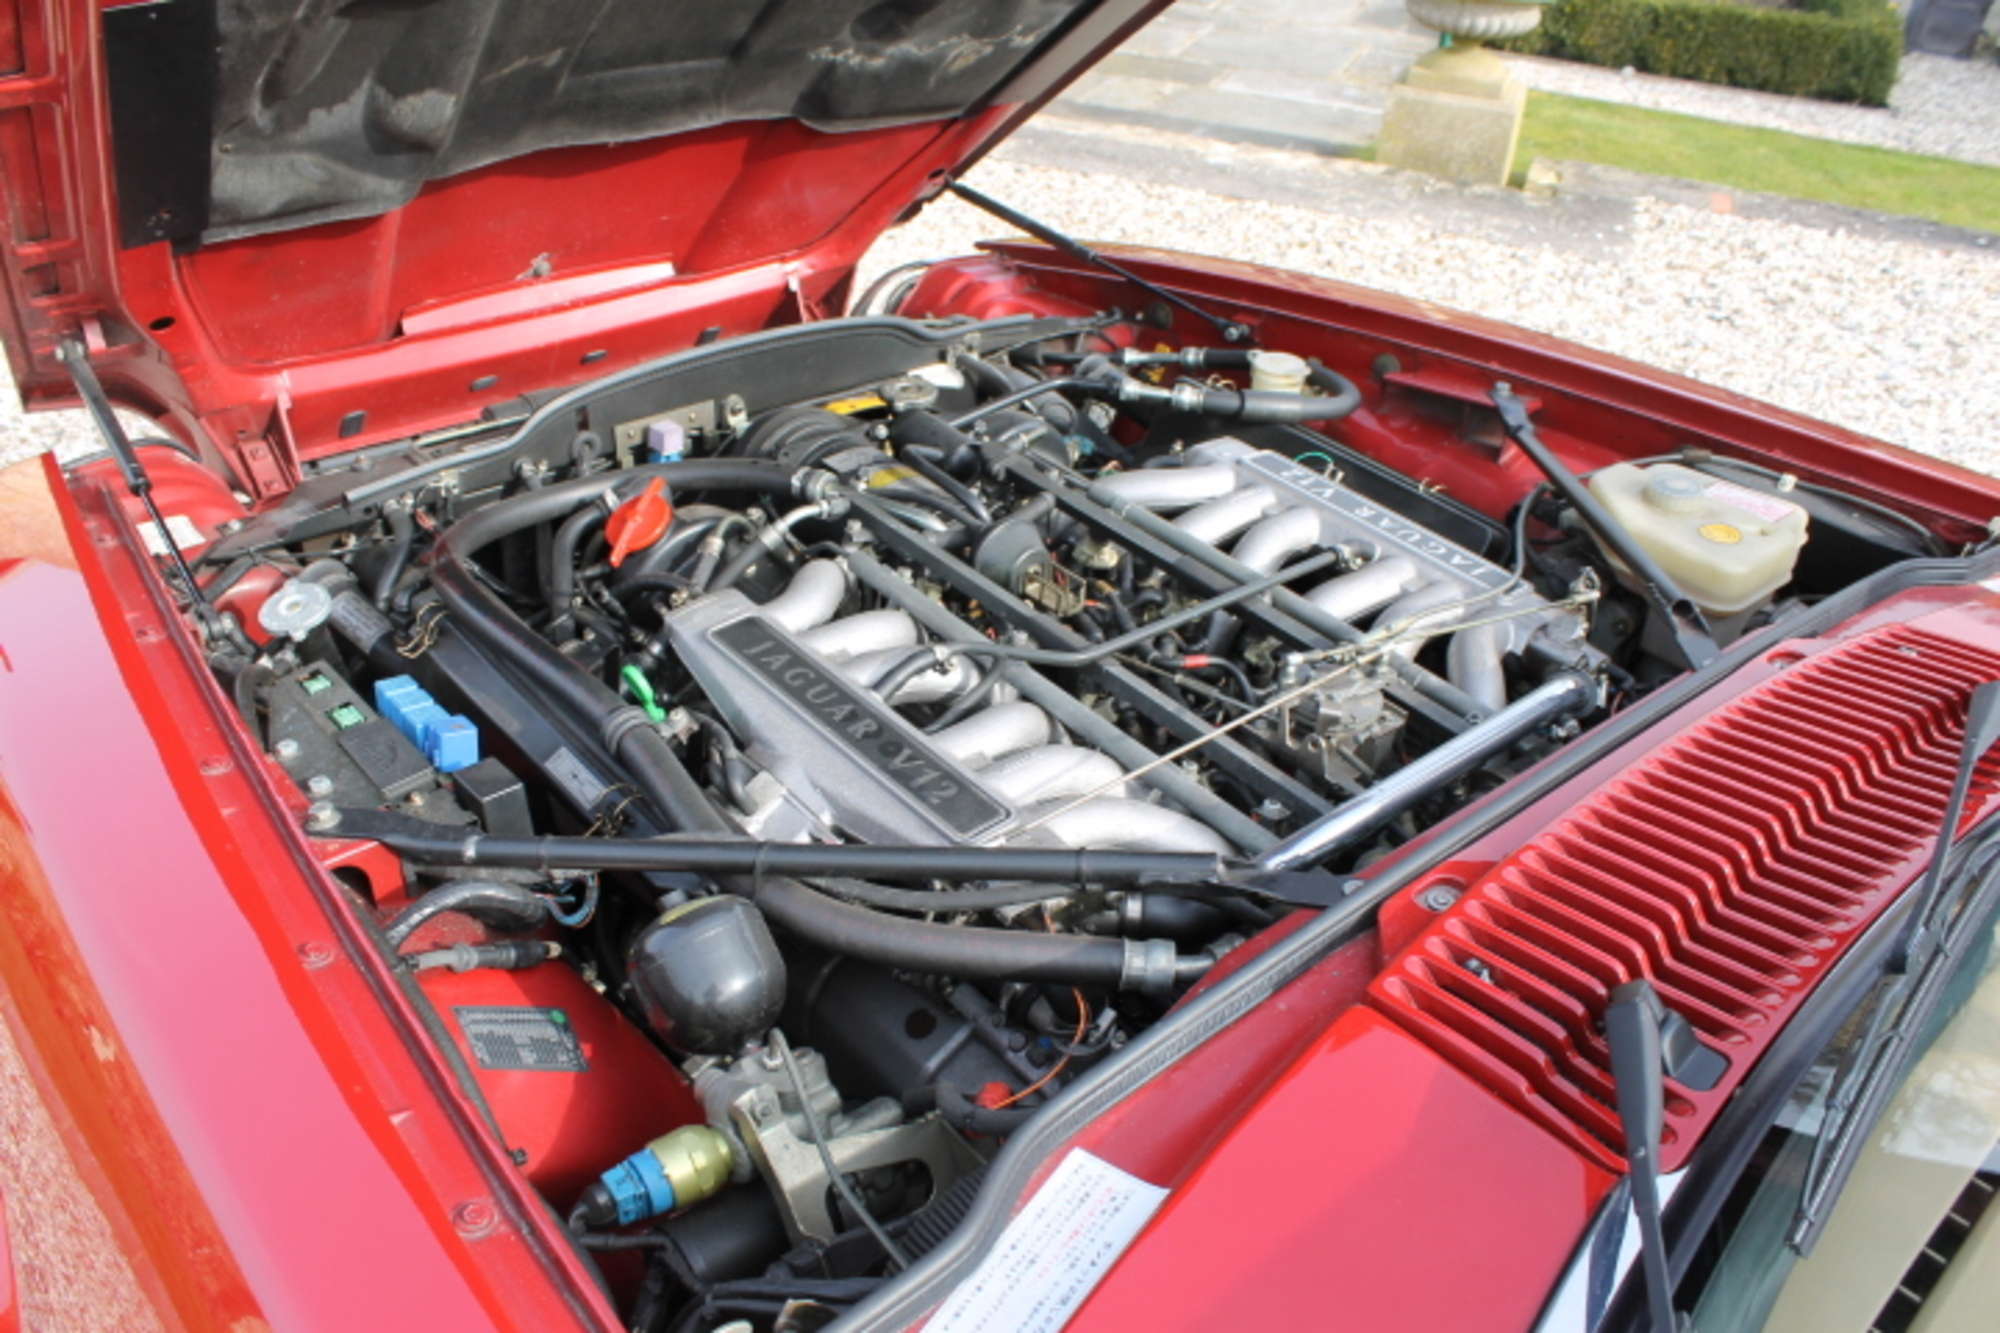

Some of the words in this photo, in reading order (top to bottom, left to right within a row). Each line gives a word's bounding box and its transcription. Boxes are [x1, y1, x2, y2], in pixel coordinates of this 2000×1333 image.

[1280, 467, 1337, 499] V12
[1355, 507, 1487, 577] JAGUAR
[744, 640, 878, 740] JAGUAR
[891, 747, 960, 805] V12
